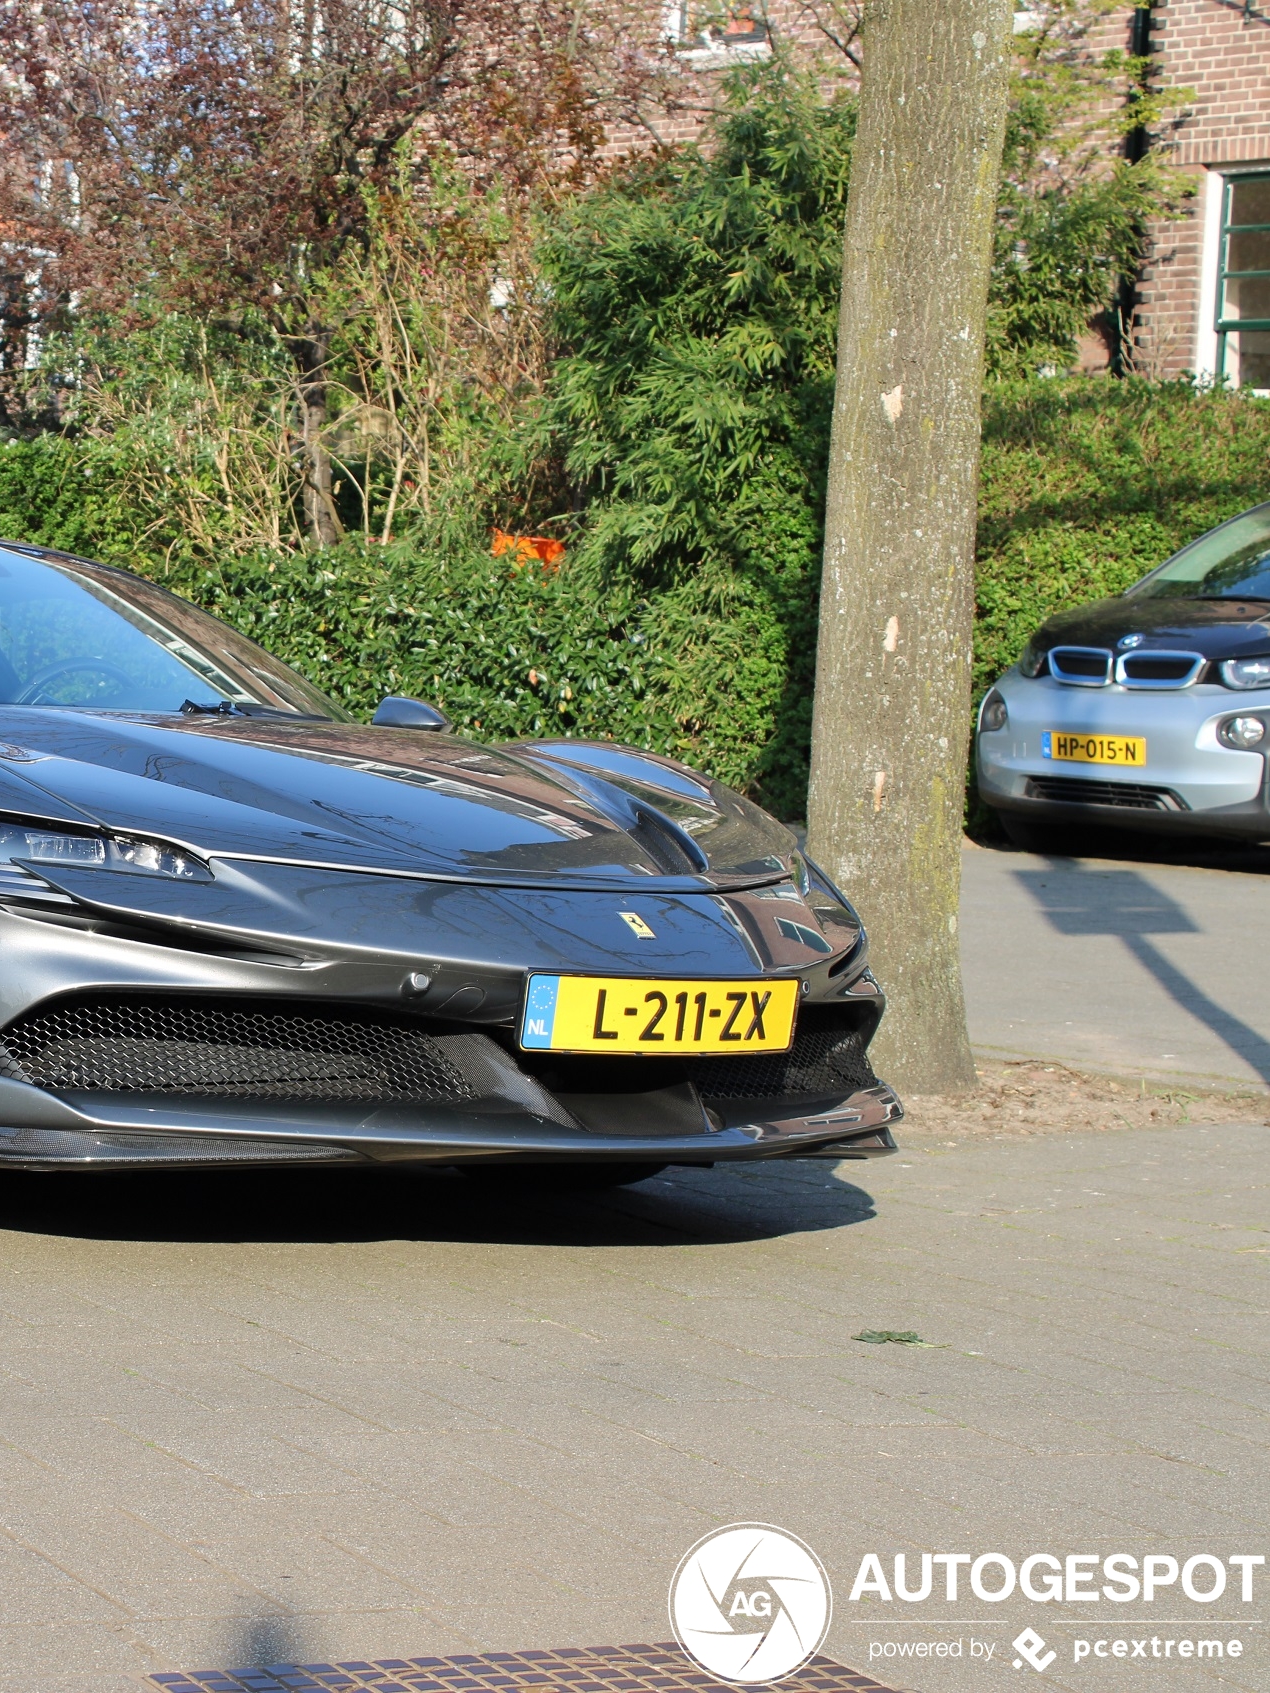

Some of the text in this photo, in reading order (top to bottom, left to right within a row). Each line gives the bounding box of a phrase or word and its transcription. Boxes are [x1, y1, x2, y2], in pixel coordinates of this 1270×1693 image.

[1057, 736, 1137, 761] HP-015-N
[527, 1018, 549, 1036] NL
[592, 988, 772, 1041] L-211-ZX
